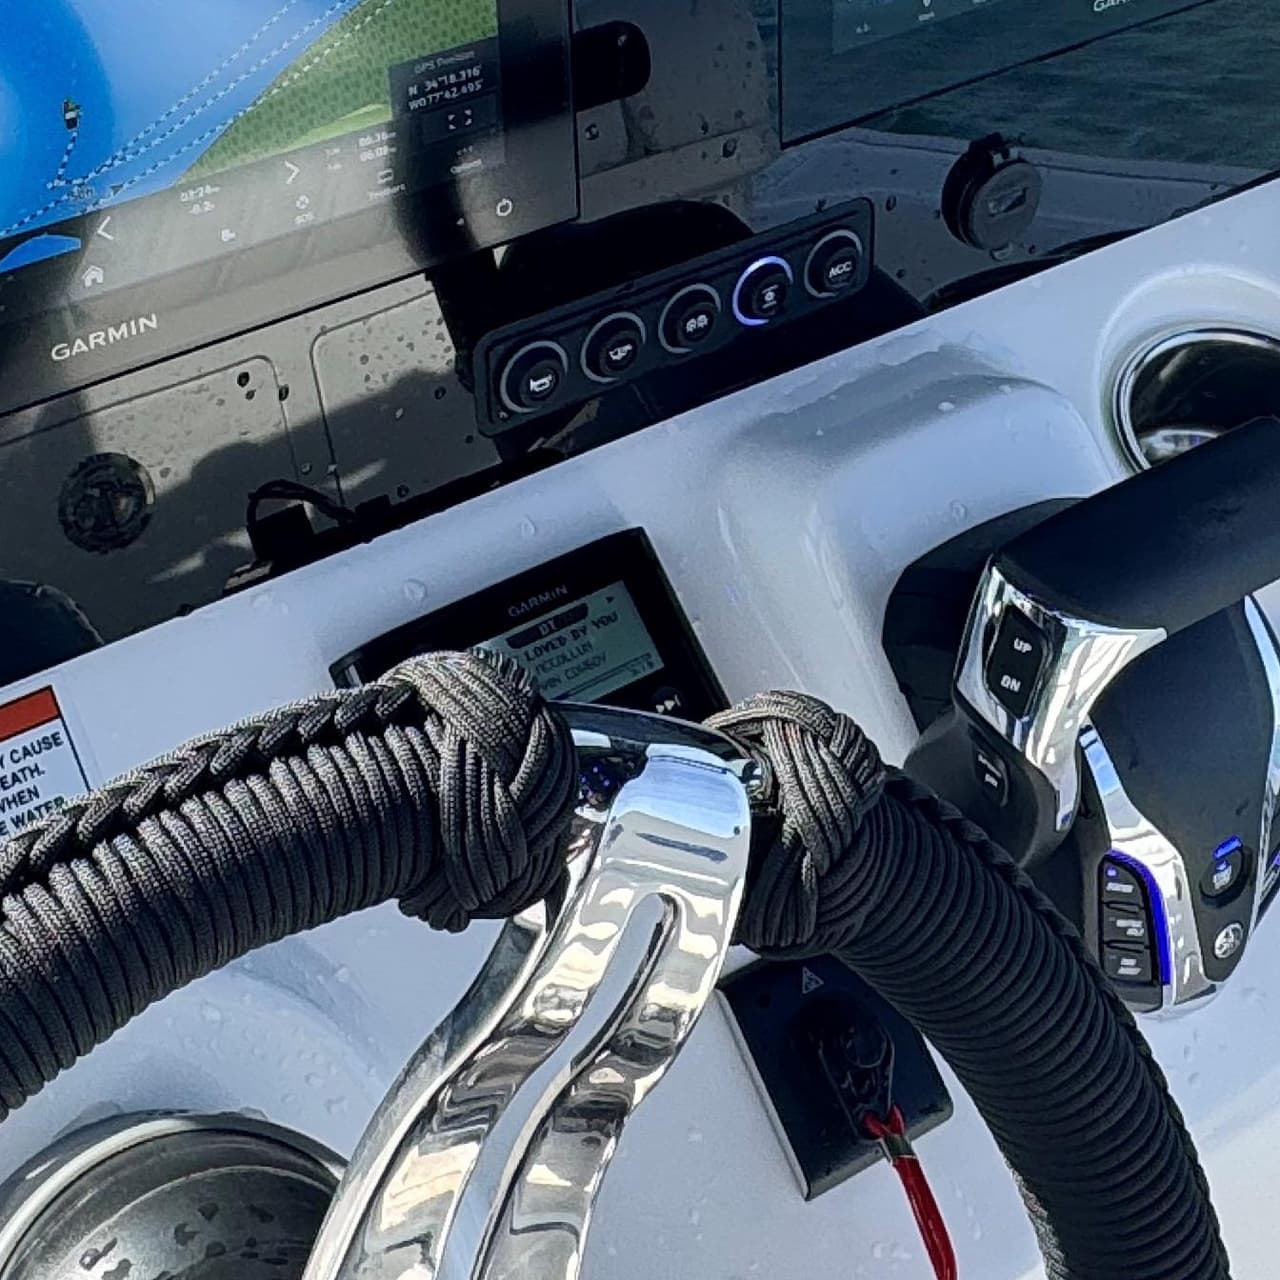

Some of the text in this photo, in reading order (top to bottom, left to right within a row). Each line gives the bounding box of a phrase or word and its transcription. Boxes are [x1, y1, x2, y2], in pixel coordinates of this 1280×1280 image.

[828, 261, 852, 280] ACC
[50, 313, 158, 361] GARMIN
[508, 584, 569, 618] GARMIN
[1013, 637, 1033, 654] UP
[9, 731, 65, 765] CAUSE
